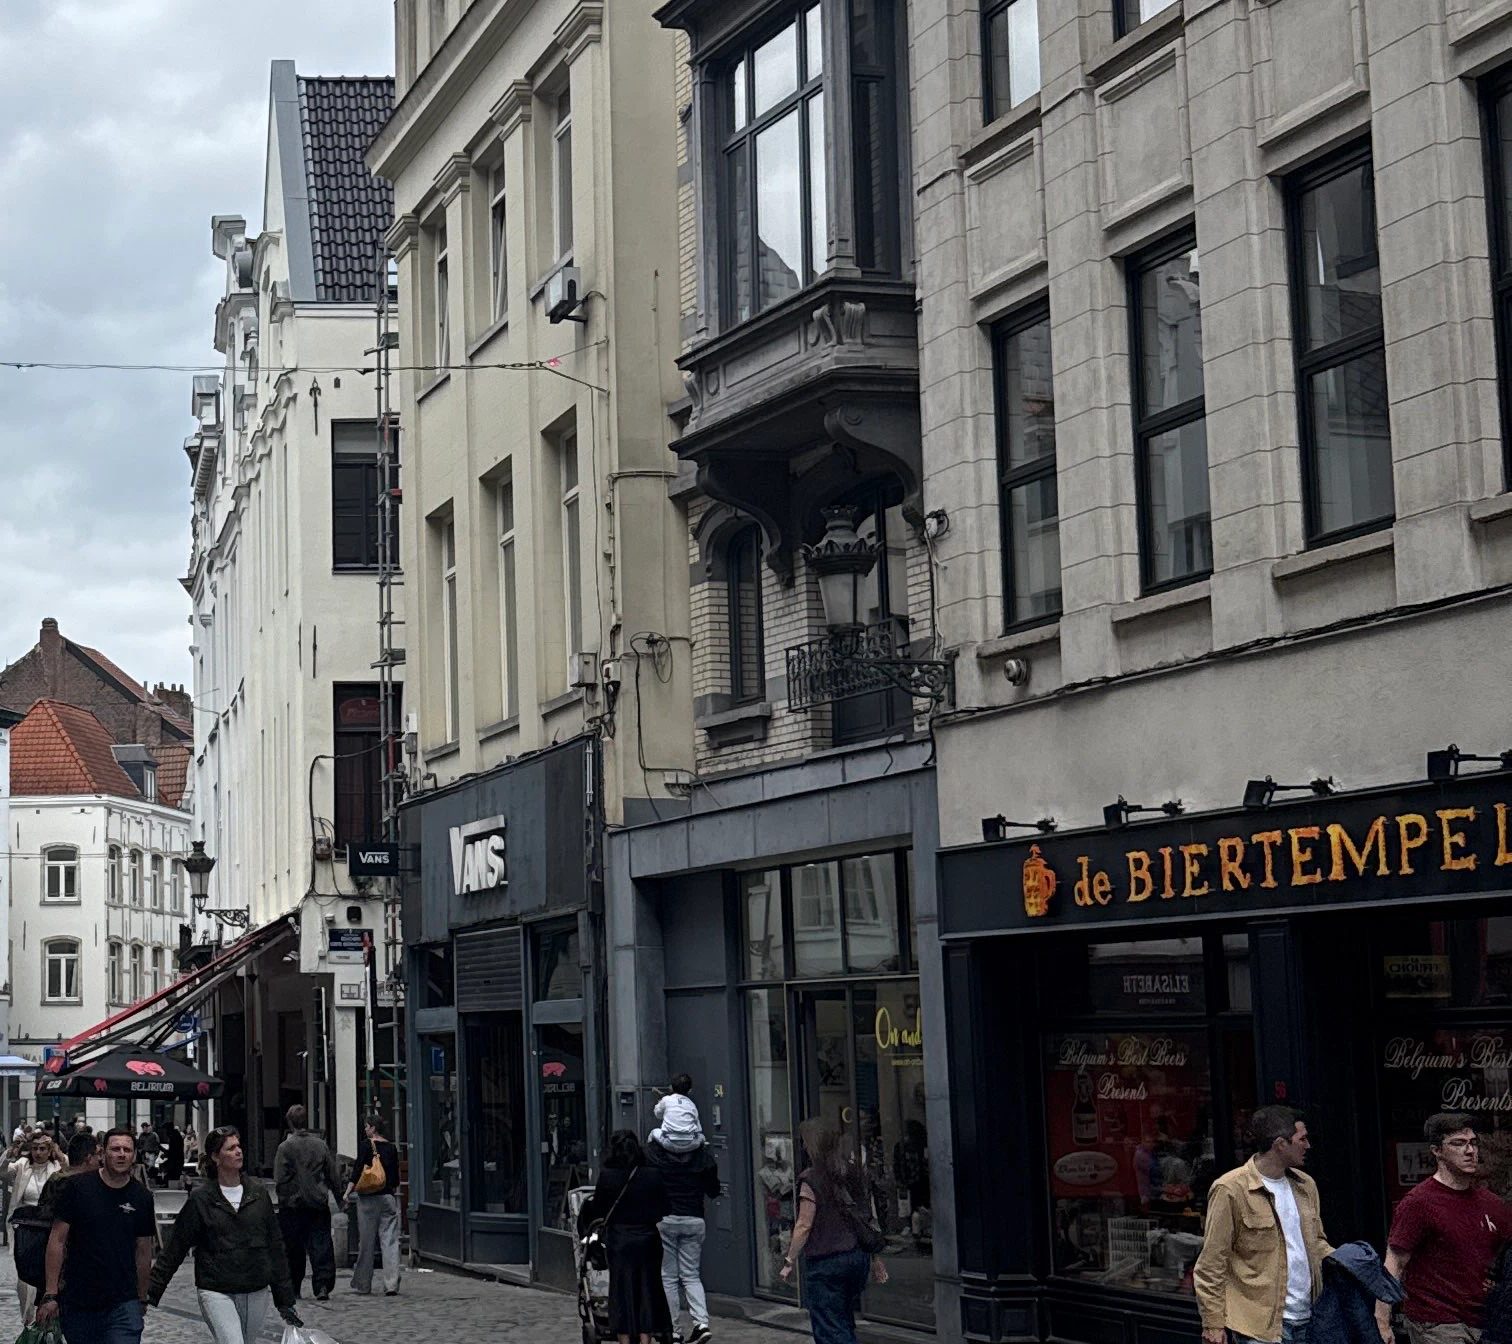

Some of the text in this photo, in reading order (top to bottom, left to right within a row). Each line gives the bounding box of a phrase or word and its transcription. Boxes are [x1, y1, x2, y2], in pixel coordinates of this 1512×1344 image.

[358, 851, 390, 864] VANS
[449, 814, 506, 896] VANS
[1073, 856, 1113, 906] de
[875, 1006, 899, 1049] On
[1118, 1037, 1149, 1066] Best
[1149, 1038, 1187, 1067] Beers
[1384, 1036, 1466, 1080] Belgium's
[1097, 1072, 1148, 1100] Presents
